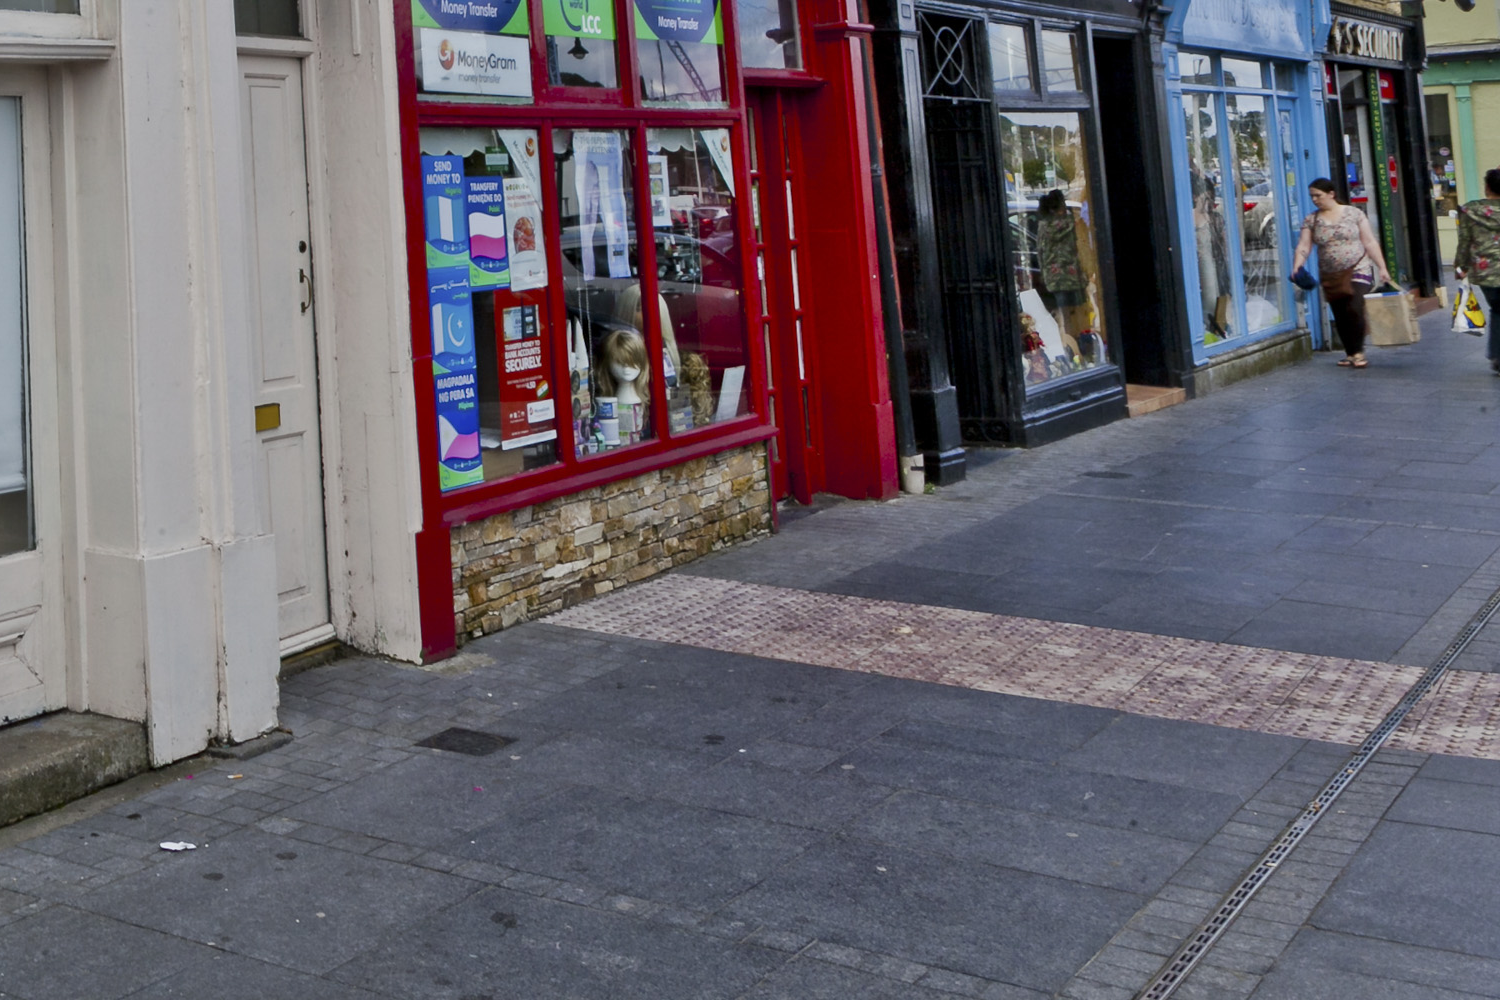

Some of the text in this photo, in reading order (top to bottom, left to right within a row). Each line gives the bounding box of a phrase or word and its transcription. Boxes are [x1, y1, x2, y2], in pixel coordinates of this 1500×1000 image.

[441, 0, 497, 18] Money Transfer
[569, 0, 583, 10] world
[582, 15, 601, 34] LCC
[658, 16, 698, 31] Money Transfer
[1356, 24, 1404, 61] SECURITY
[458, 50, 516, 72] MoneyGram
[1373, 109, 1383, 151] SERVICE
[1379, 163, 1387, 187] KEYS
[434, 161, 452, 172] SEND
[426, 173, 461, 185] MONEY TO
[470, 182, 498, 191] TRANSFERY
[493, 193, 502, 203] DO
[505, 354, 542, 373] SECURELY.
[437, 374, 475, 389] MAGPADALA
[439, 387, 475, 403] NG PERA SA
